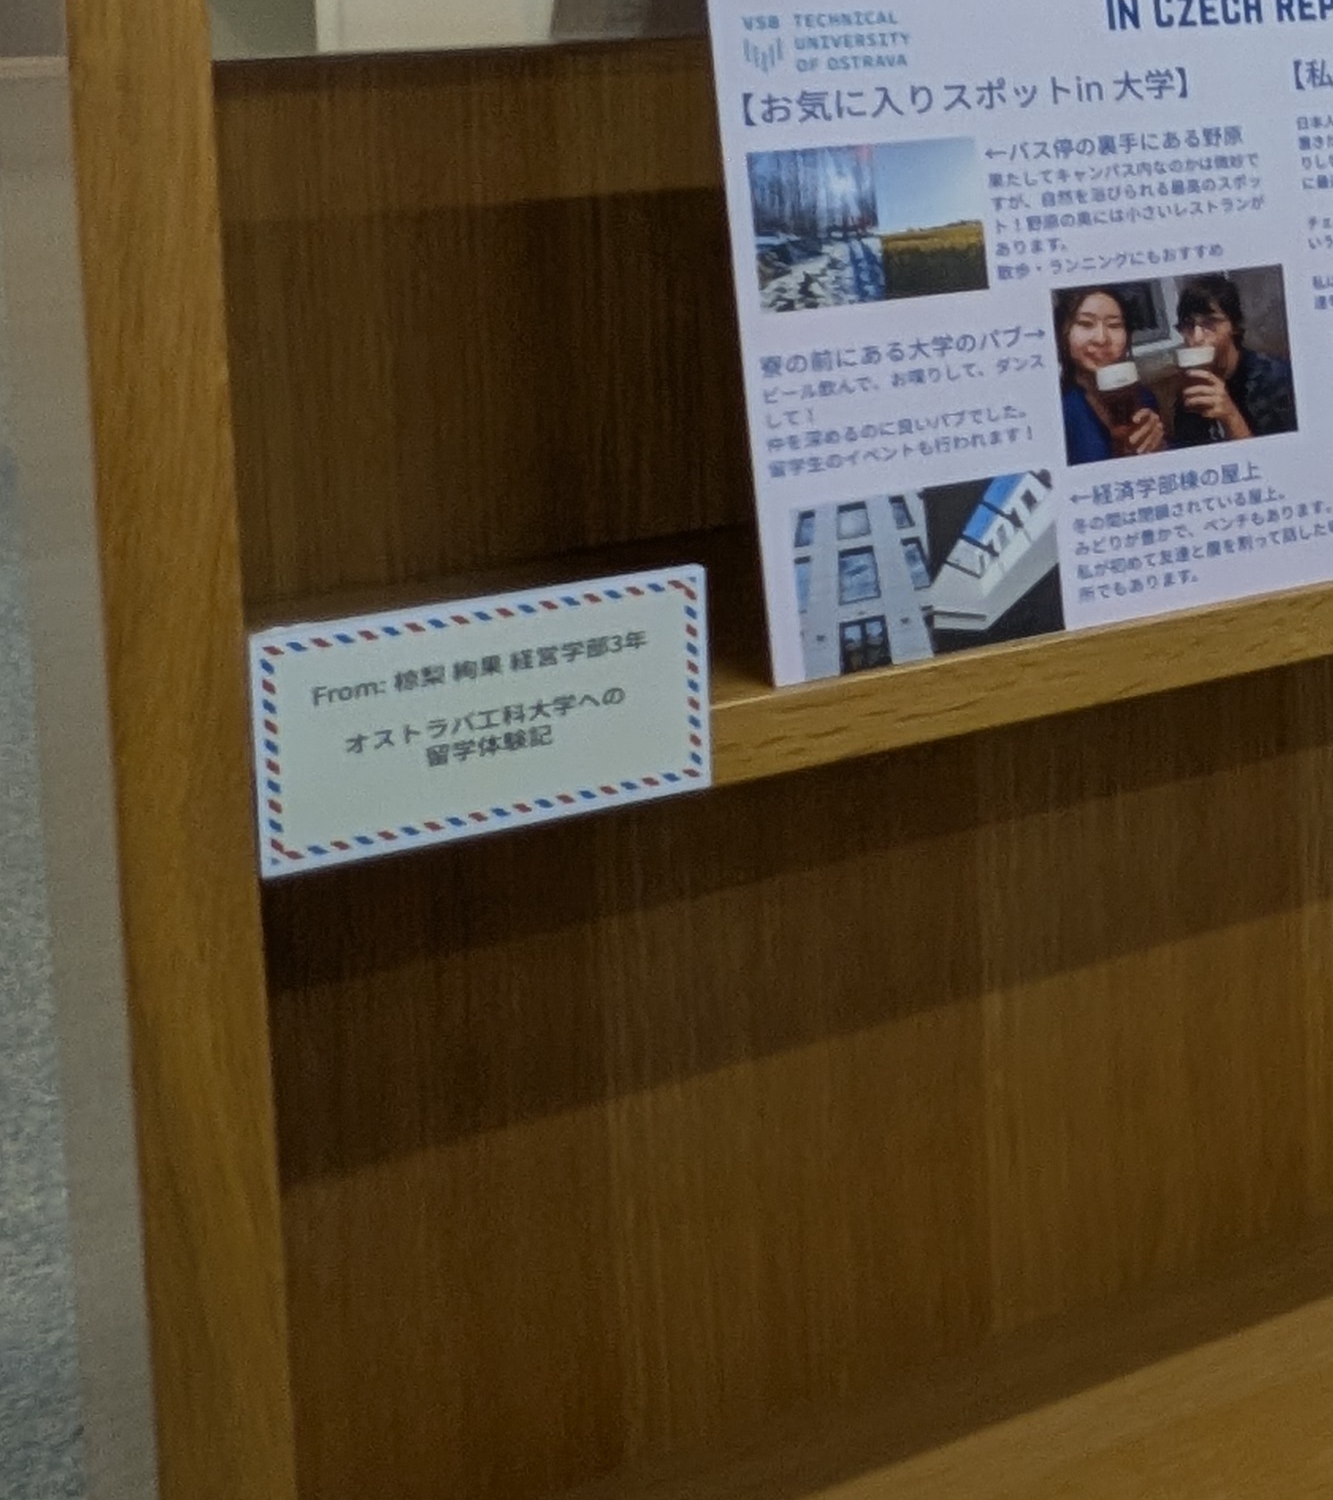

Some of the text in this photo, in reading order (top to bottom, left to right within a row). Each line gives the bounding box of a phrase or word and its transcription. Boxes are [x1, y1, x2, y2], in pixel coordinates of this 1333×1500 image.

[740, 9, 899, 31] VSB TECHNICAL
[793, 31, 912, 52] UNIVERSITY
[795, 53, 909, 73] OF OSTRAVA
[1111, 65, 1190, 103] 大学】
[311, 675, 386, 707] From:
[345, 685, 627, 756] オストラバ工科大学への
[425, 723, 553, 768] 留学体験記
